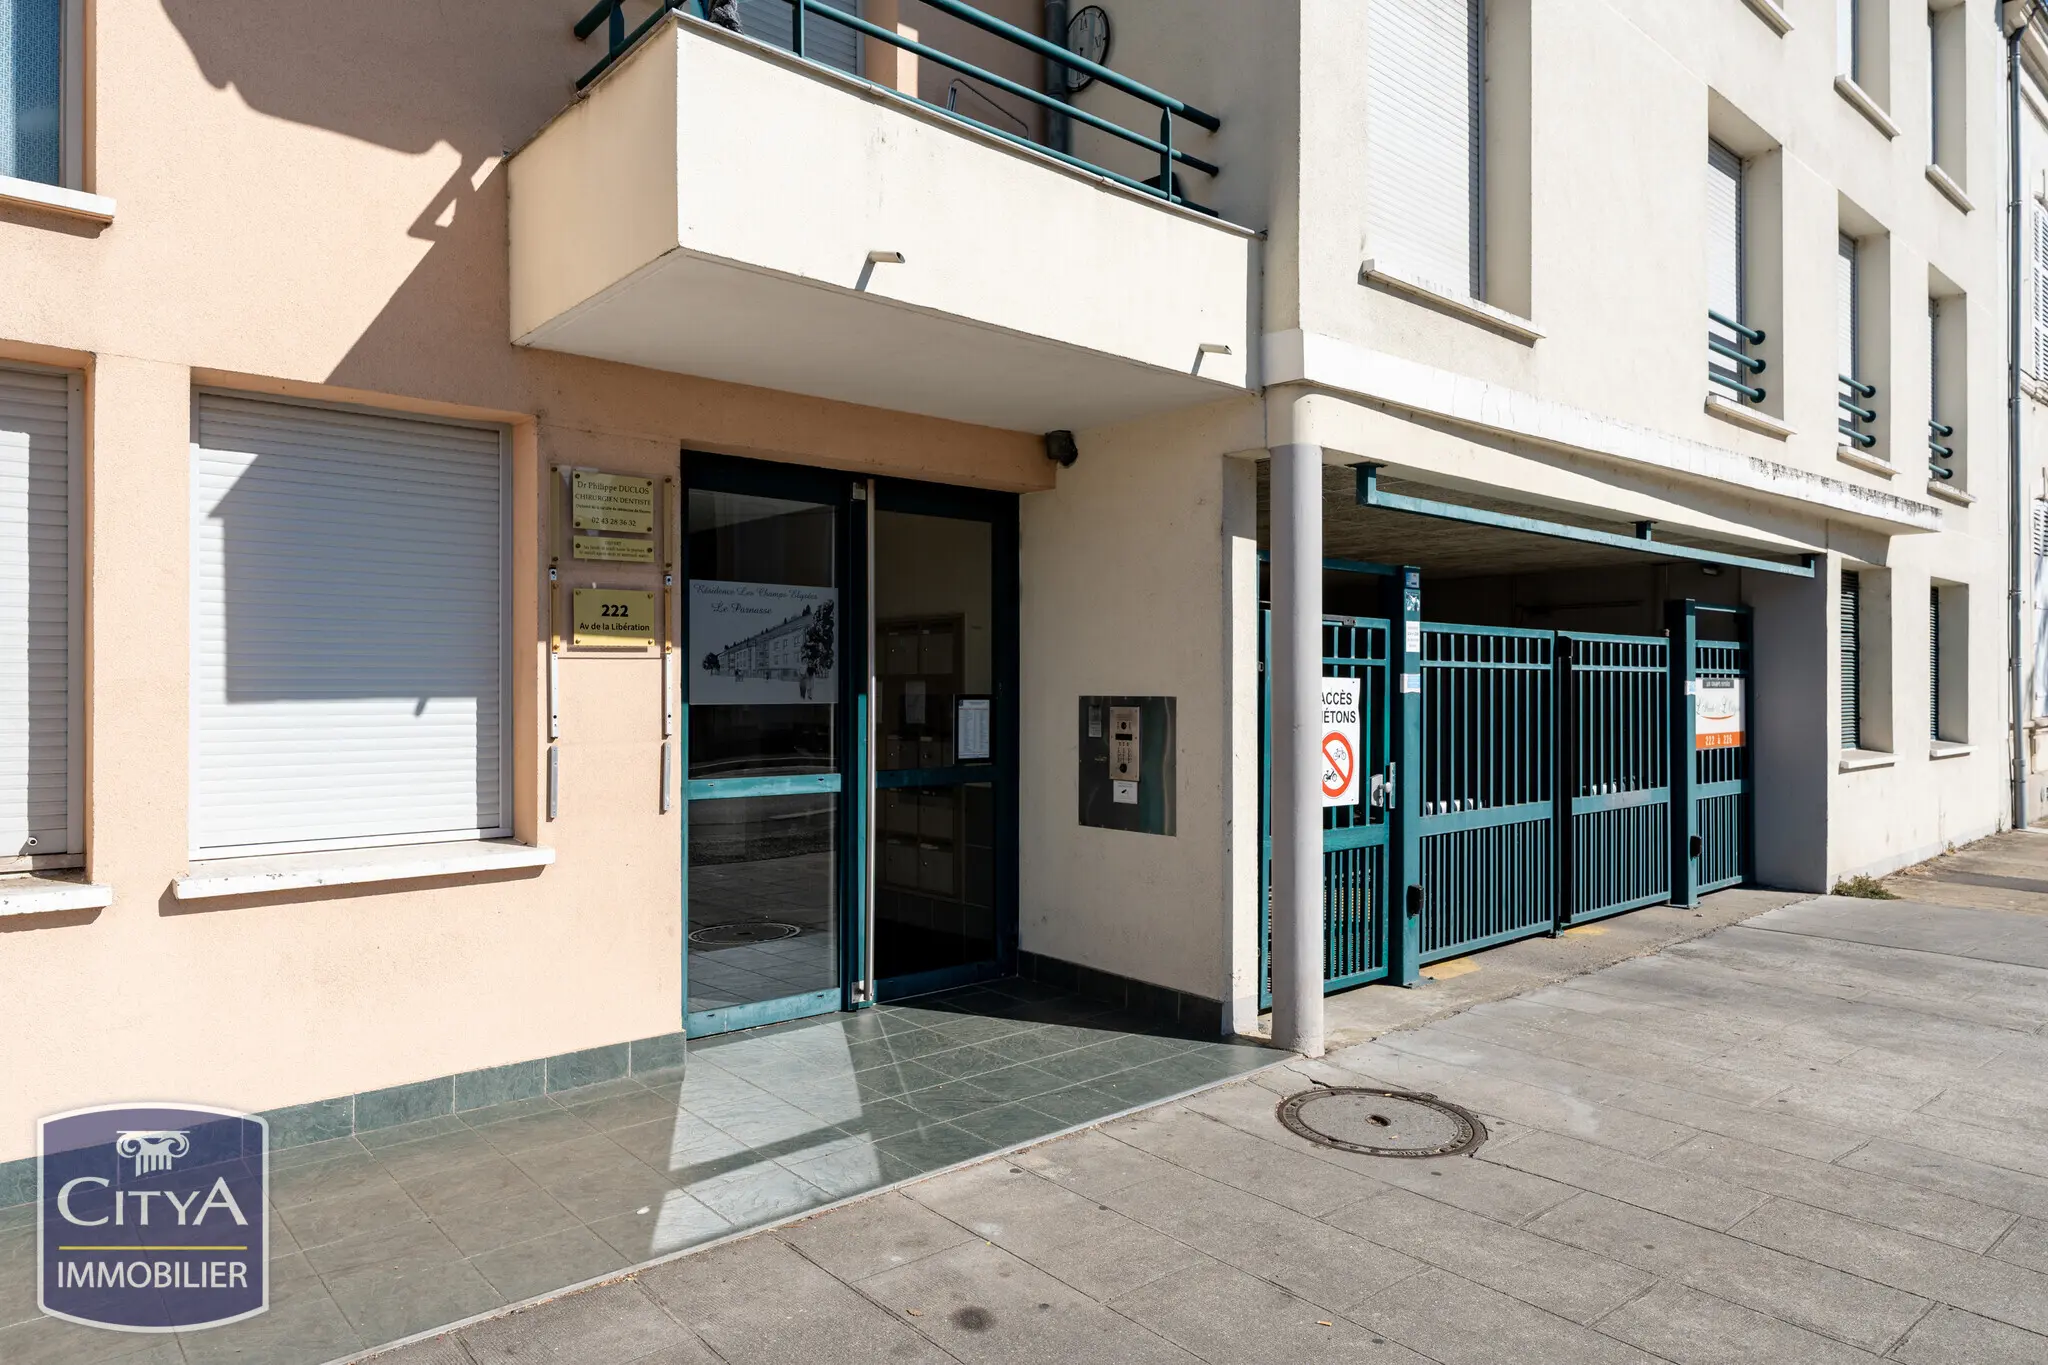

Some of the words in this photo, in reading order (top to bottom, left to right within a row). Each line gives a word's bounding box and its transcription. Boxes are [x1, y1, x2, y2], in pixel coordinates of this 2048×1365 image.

[577, 481, 587, 489] Dr
[588, 482, 617, 493] Philippe
[618, 485, 649, 494] DUCLOS
[575, 493, 619, 502] CHIRURGIEN
[693, 584, 735, 596] Résidence
[736, 587, 754, 596] Les
[601, 604, 629, 617] 222
[711, 601, 729, 613] Le
[591, 622, 601, 630] de
[611, 623, 650, 631] Libération
[1705, 735, 1715, 746] 222
